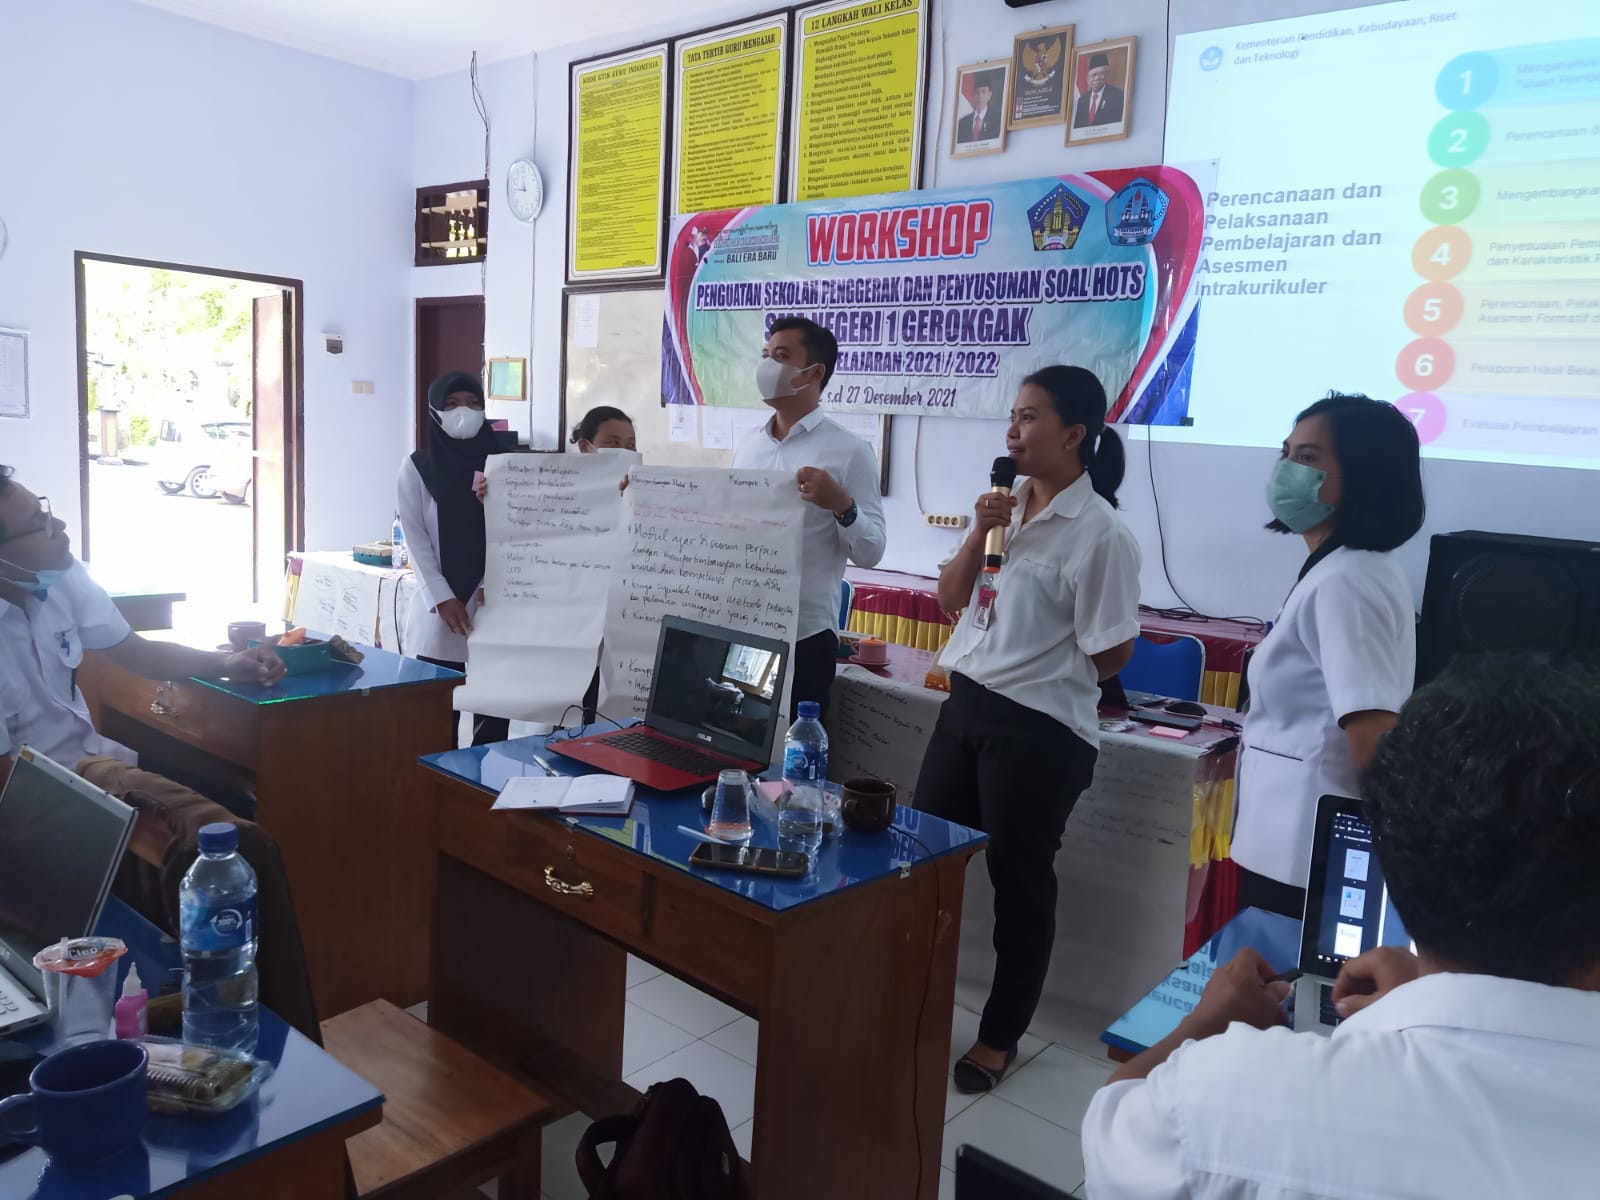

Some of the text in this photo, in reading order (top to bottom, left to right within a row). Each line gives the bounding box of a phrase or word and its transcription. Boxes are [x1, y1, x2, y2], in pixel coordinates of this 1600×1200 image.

[811, 0, 913, 30] 12 LANGKAH WALI KELAS
[1235, 11, 1457, 51] Kementerian Pendidikan, Kebudayaan, Riset
[687, 33, 776, 63] TATA TERTIB GURU MENGAJAR
[1234, 49, 1300, 65] dan Teknologi
[628, 60, 659, 74] INDONESIA
[1460, 70, 1472, 95] 1
[1448, 128, 1468, 153] 2
[1206, 182, 1382, 208] Perencanaan dan
[1439, 186, 1459, 210] 3
[1204, 211, 1328, 230] Pelaksanaan
[807, 200, 992, 265] WORKSHOP
[1201, 230, 1382, 253] Pembelajaran dan
[726, 254, 742, 264] BALI
[743, 252, 757, 263] ERA
[758, 251, 777, 262] BARU
[1430, 242, 1451, 266] 4
[1486, 256, 1509, 266] dan
[1197, 258, 1288, 275] Asesmen
[696, 264, 1144, 308] PENGUATAN SEKOLAH PENGGERAK DAN PENYUSUNAN SOAL HOTS
[1194, 278, 1328, 297] Intrakurikuler
[1423, 298, 1441, 321] 5
[886, 308, 897, 343] 1
[901, 307, 1030, 344] GEROKGAK
[836, 351, 902, 373] ELAJARAN
[1414, 353, 1434, 377] 6
[846, 386, 860, 404] 27
[863, 386, 923, 407] Desember
[927, 388, 957, 408] 2021
[1408, 408, 1426, 428] 7
[696, 733, 712, 742] ASUS
[68, 946, 98, 961] Cleo
